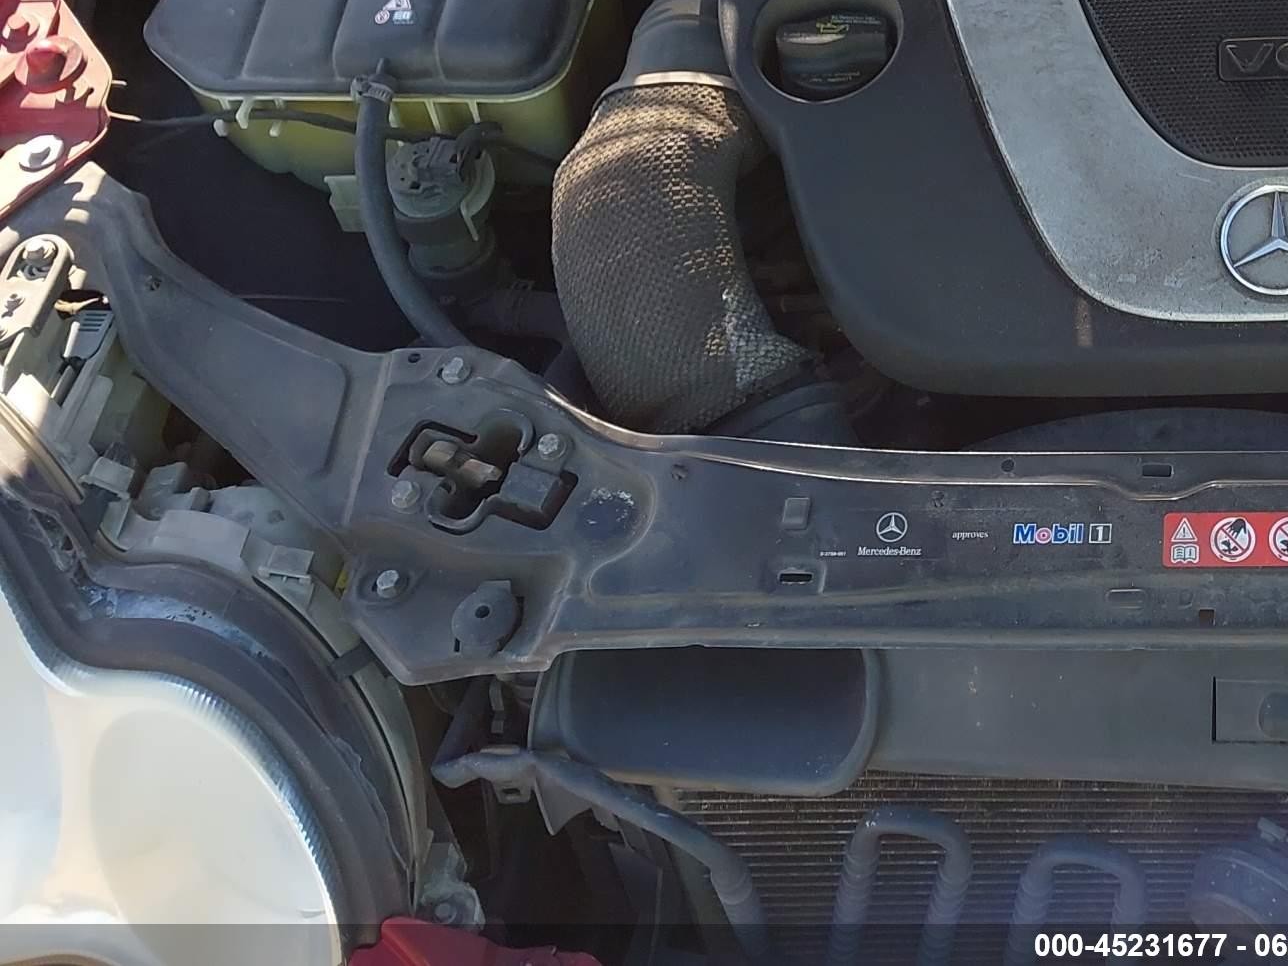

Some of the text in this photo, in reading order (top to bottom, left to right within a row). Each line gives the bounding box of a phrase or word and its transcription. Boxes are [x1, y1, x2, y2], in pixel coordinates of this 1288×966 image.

[952, 530, 989, 540] approves
[1012, 523, 1085, 544] Mobil
[857, 546, 922, 556] Mercedes-Benz
